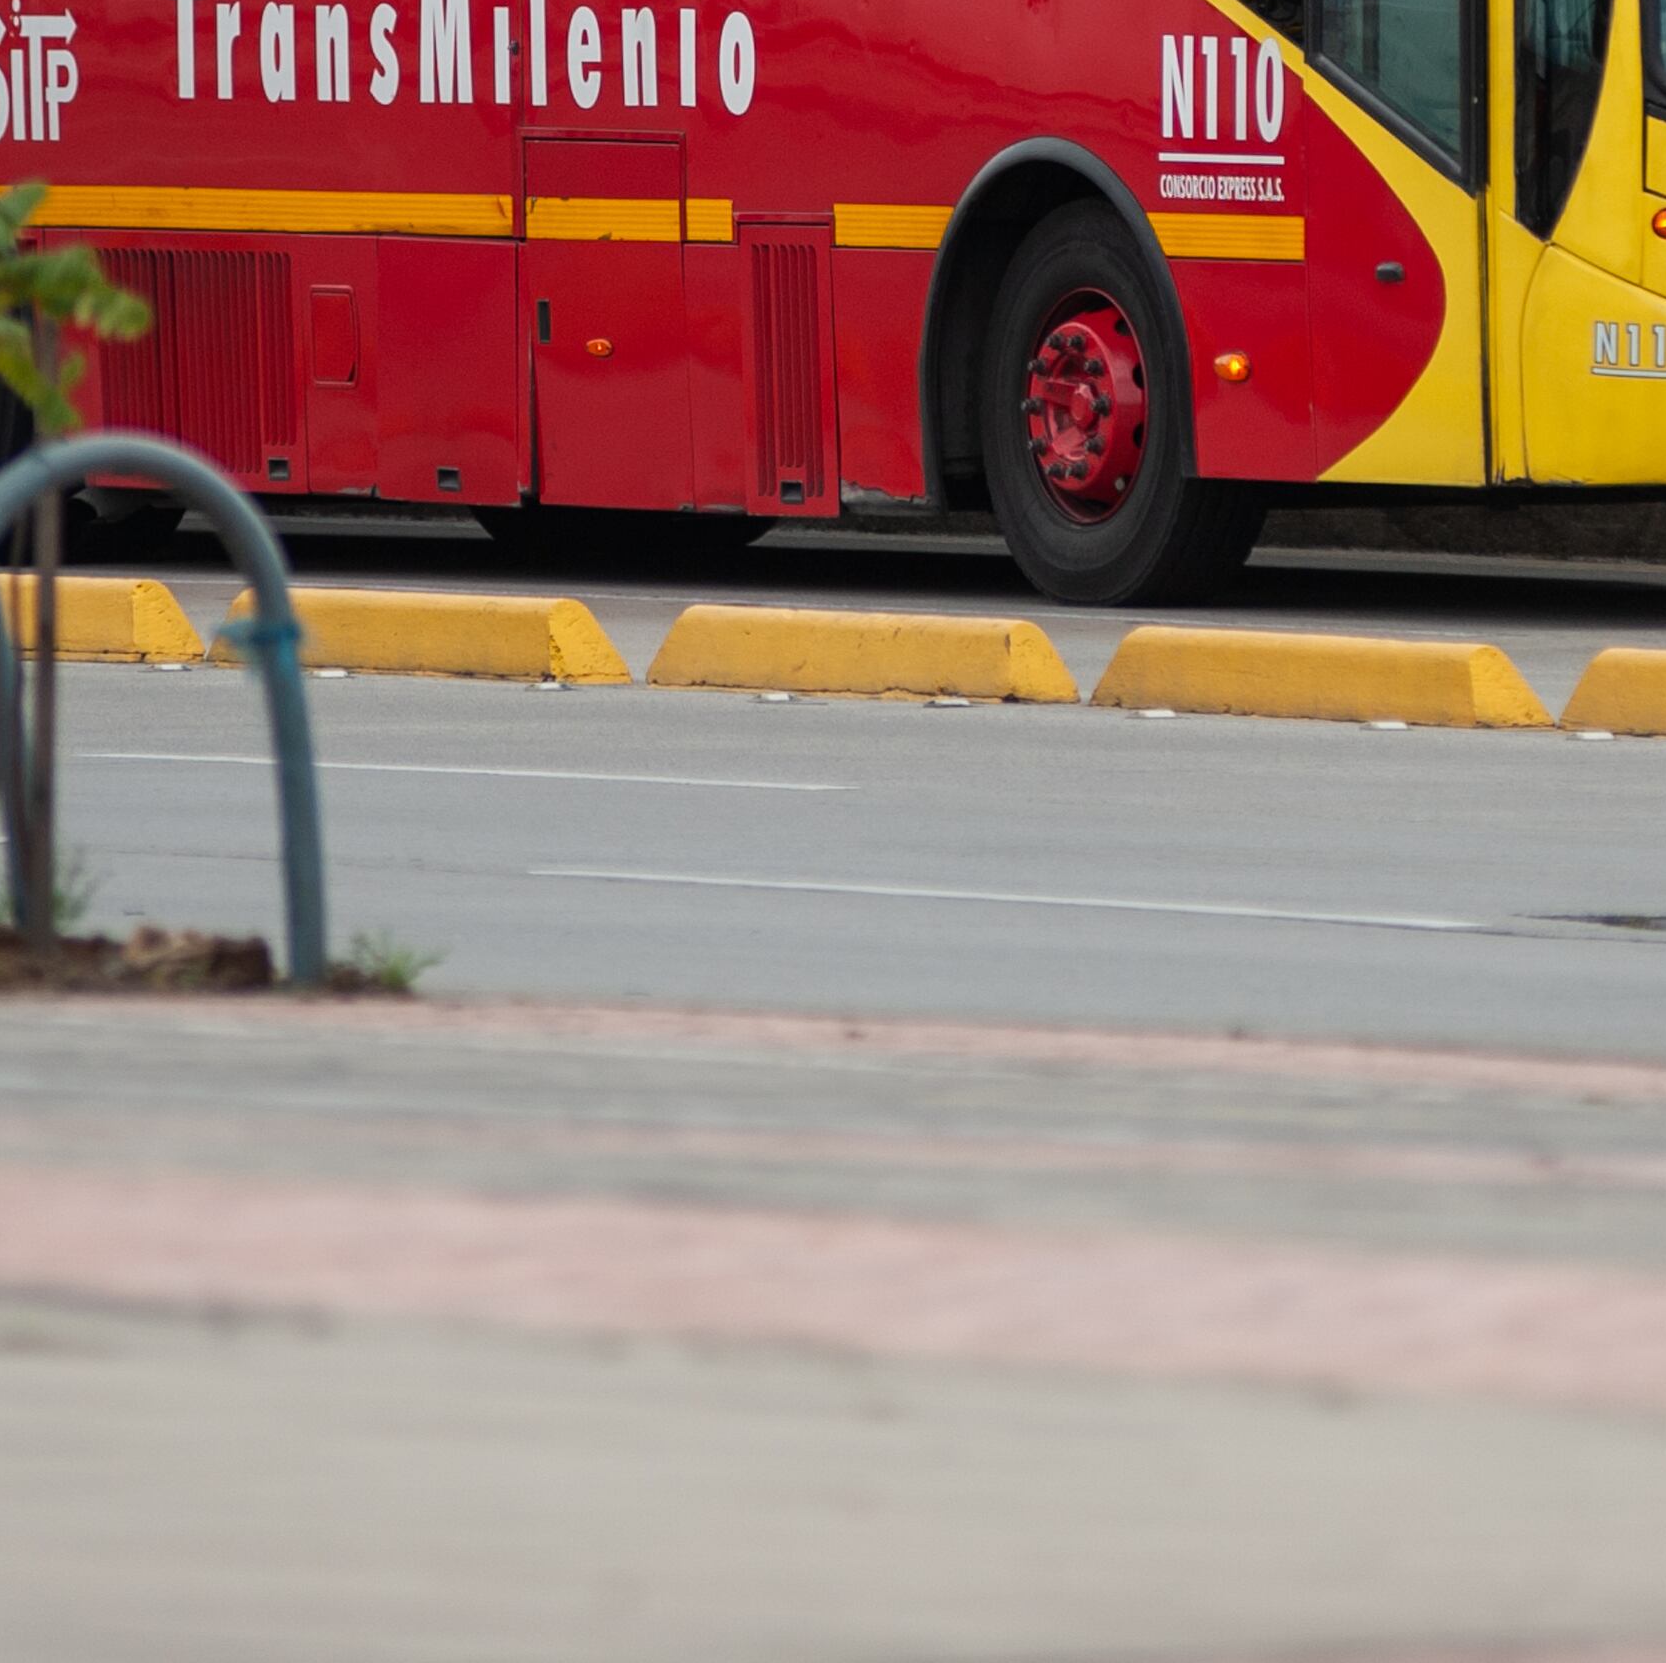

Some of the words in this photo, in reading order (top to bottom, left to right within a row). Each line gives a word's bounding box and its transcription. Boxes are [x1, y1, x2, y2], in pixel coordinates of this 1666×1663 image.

[1162, 34, 1284, 143] N110
[1160, 174, 1216, 199] CONSORCIO
[1217, 175, 1257, 201] EXPRESS
